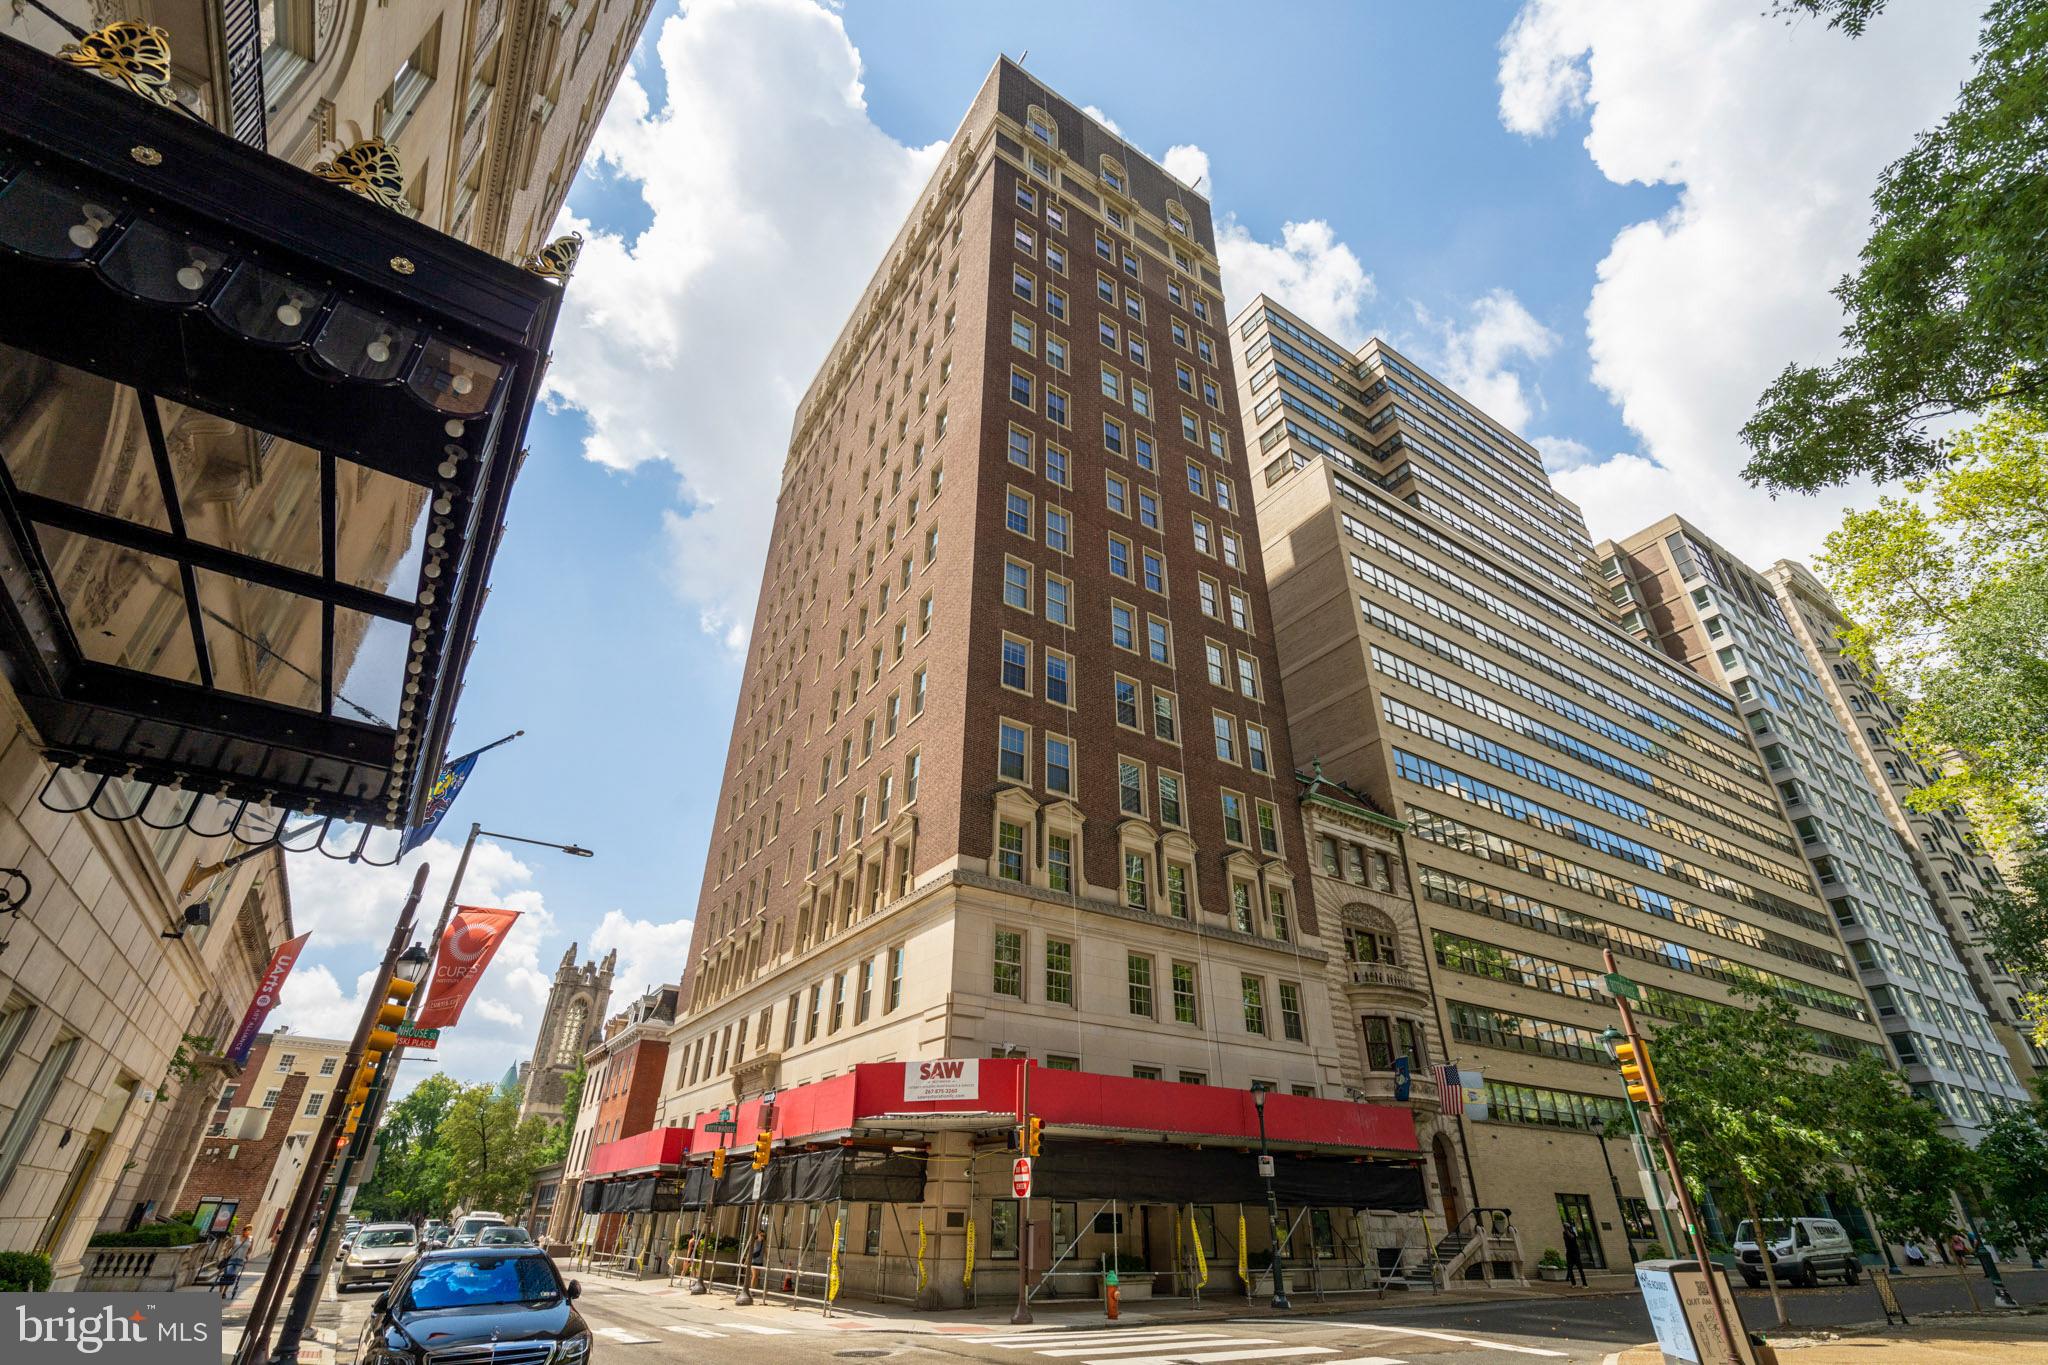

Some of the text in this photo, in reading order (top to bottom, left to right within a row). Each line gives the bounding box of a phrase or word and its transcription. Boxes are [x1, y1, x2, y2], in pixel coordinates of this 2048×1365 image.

[262, 955, 292, 993] UArts
[411, 1039, 432, 1047] PLACE
[920, 1061, 964, 1080] SAW
